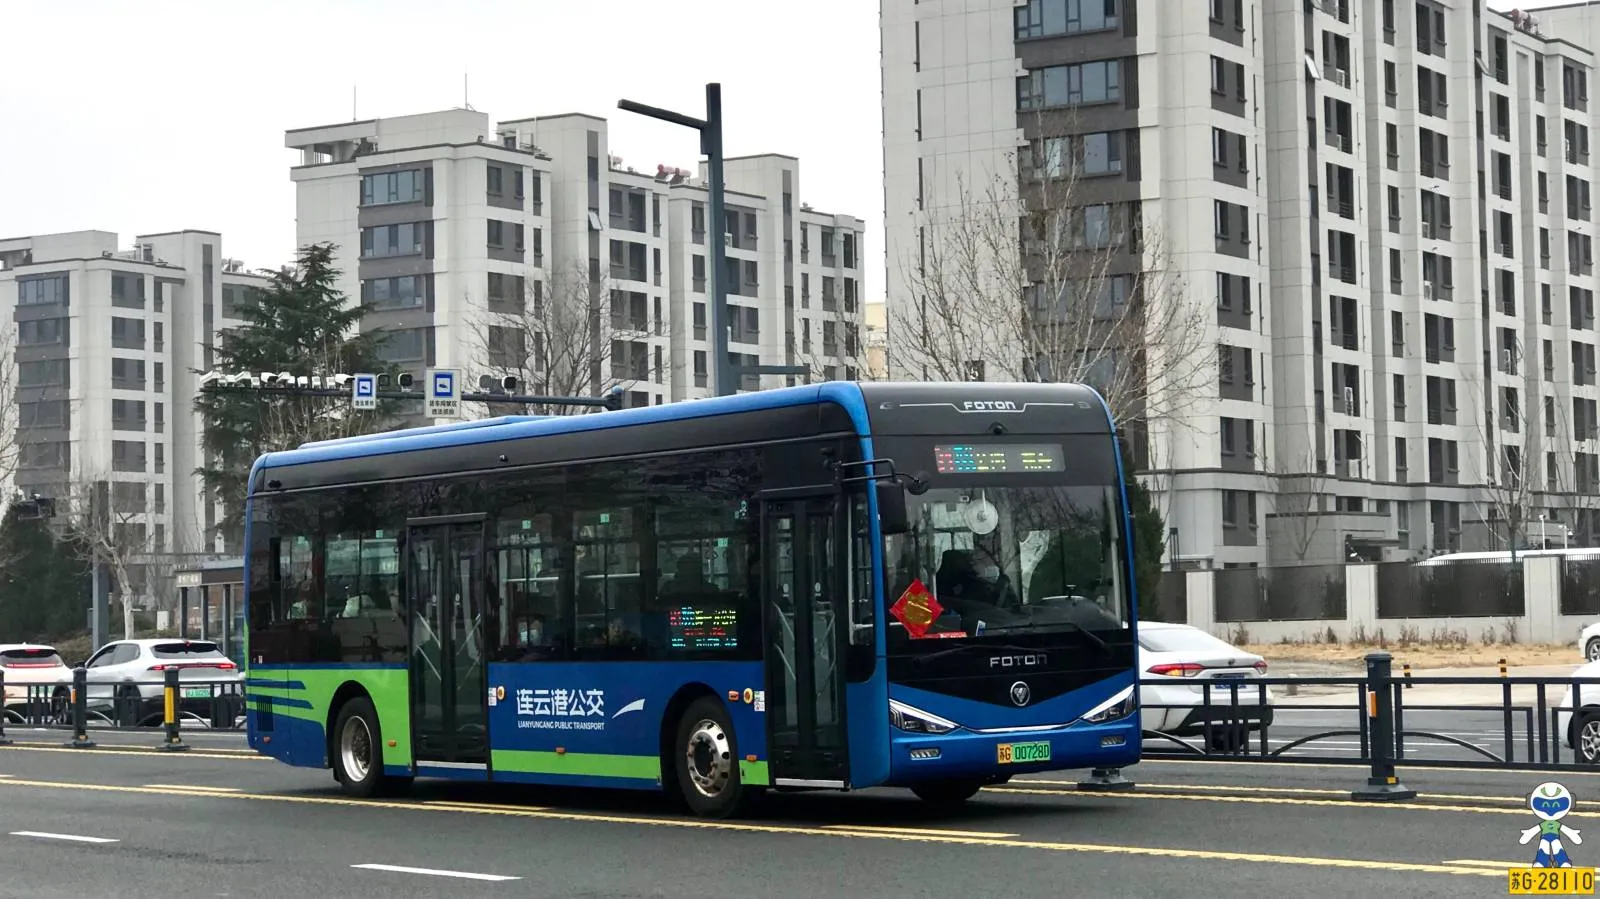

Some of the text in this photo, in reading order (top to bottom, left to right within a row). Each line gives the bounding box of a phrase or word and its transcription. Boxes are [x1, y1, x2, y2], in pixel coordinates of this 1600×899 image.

[963, 401, 1016, 410] FOTON
[990, 655, 1047, 668] FOTON
[516, 688, 605, 717] 连云港公交
[555, 721, 572, 730] PUBLIC
[573, 722, 605, 731] TRANSPORT
